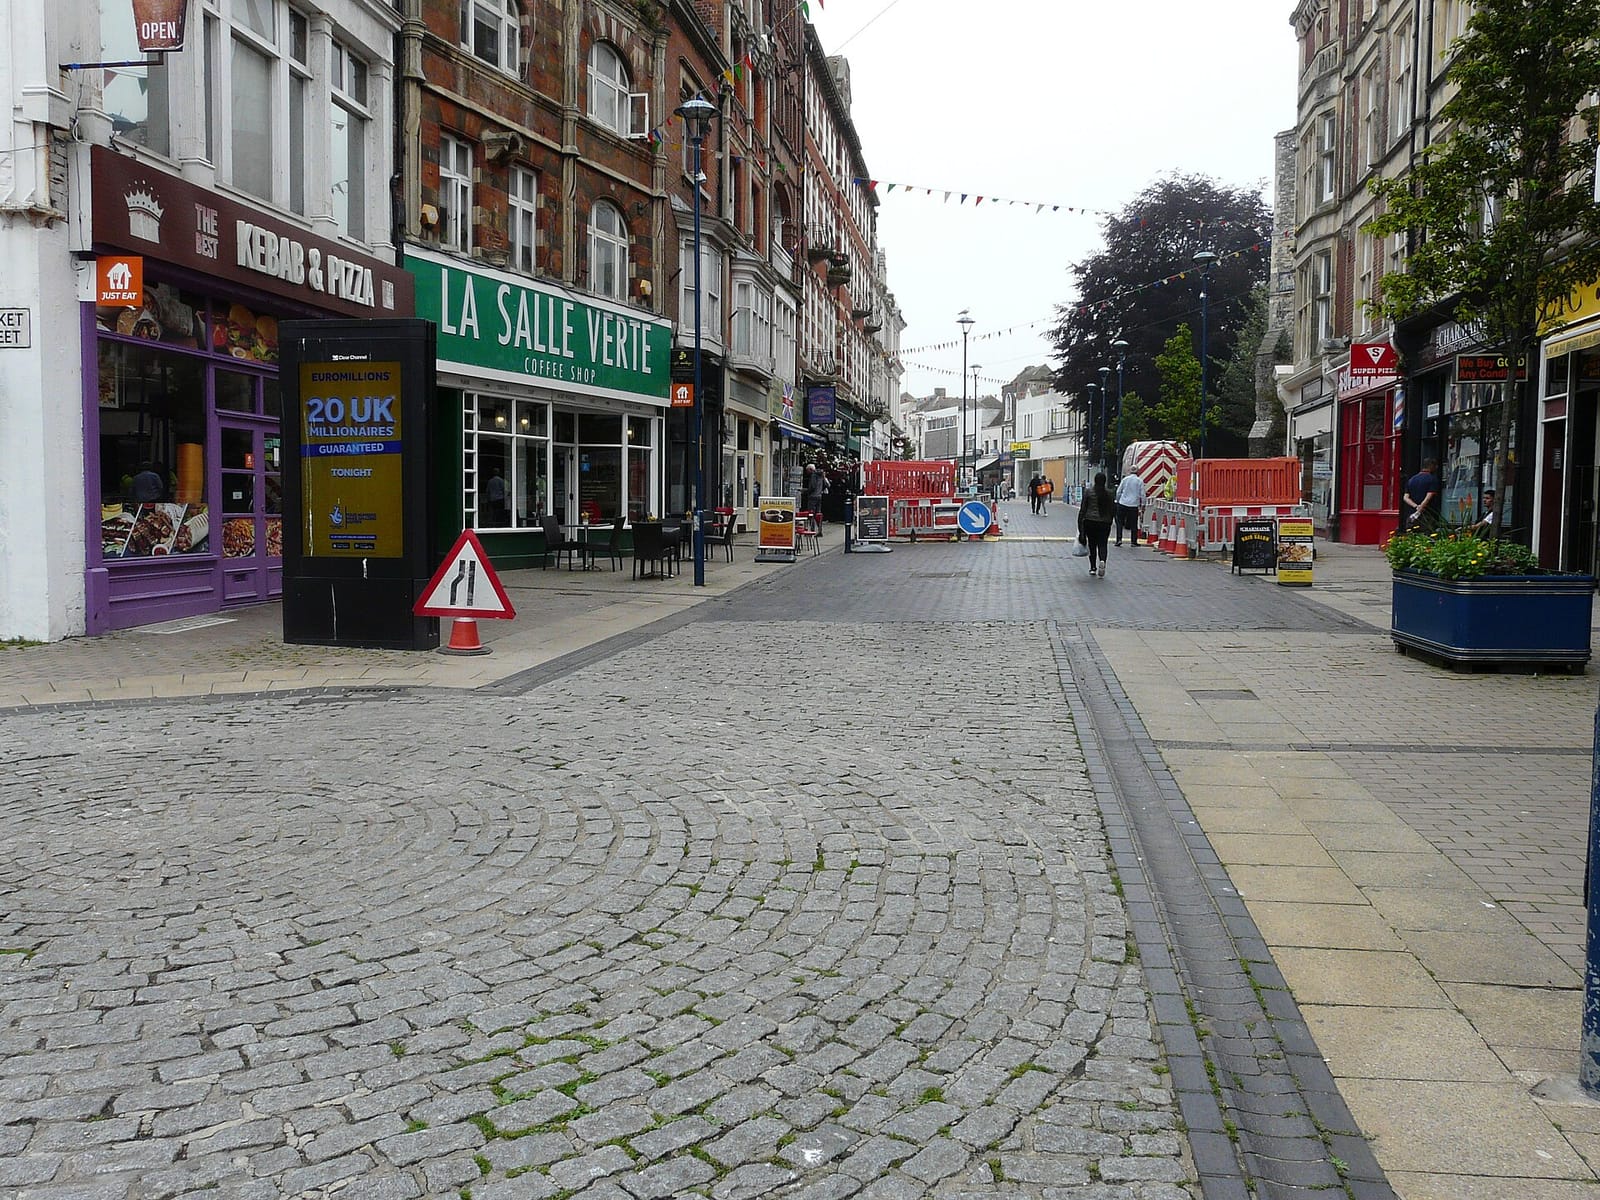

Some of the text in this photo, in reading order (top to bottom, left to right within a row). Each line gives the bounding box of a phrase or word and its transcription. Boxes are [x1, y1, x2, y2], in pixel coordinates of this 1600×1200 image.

[142, 21, 176, 39] OPEN
[194, 202, 218, 236] THE
[195, 231, 219, 259] BEST
[236, 219, 305, 285] KEBAB
[308, 248, 324, 292] &
[327, 254, 375, 307] PIZZA
[101, 292, 137, 300] JUST EAT
[441, 268, 480, 340] LA
[497, 283, 574, 359] SALLE
[587, 307, 652, 374] VERTE
[1372, 348, 1380, 357] S
[1460, 357, 1525, 370] We Buy GOD
[311, 371, 391, 382] EUROMILLIONS
[524, 357, 597, 384] COFFEE SHOP
[1460, 369, 1477, 379] Any
[306, 396, 396, 423] 20 UK
[309, 426, 394, 437] MILLIONAIRES
[319, 443, 385, 454] GUARANTEED
[331, 468, 373, 477] TONIGHT
